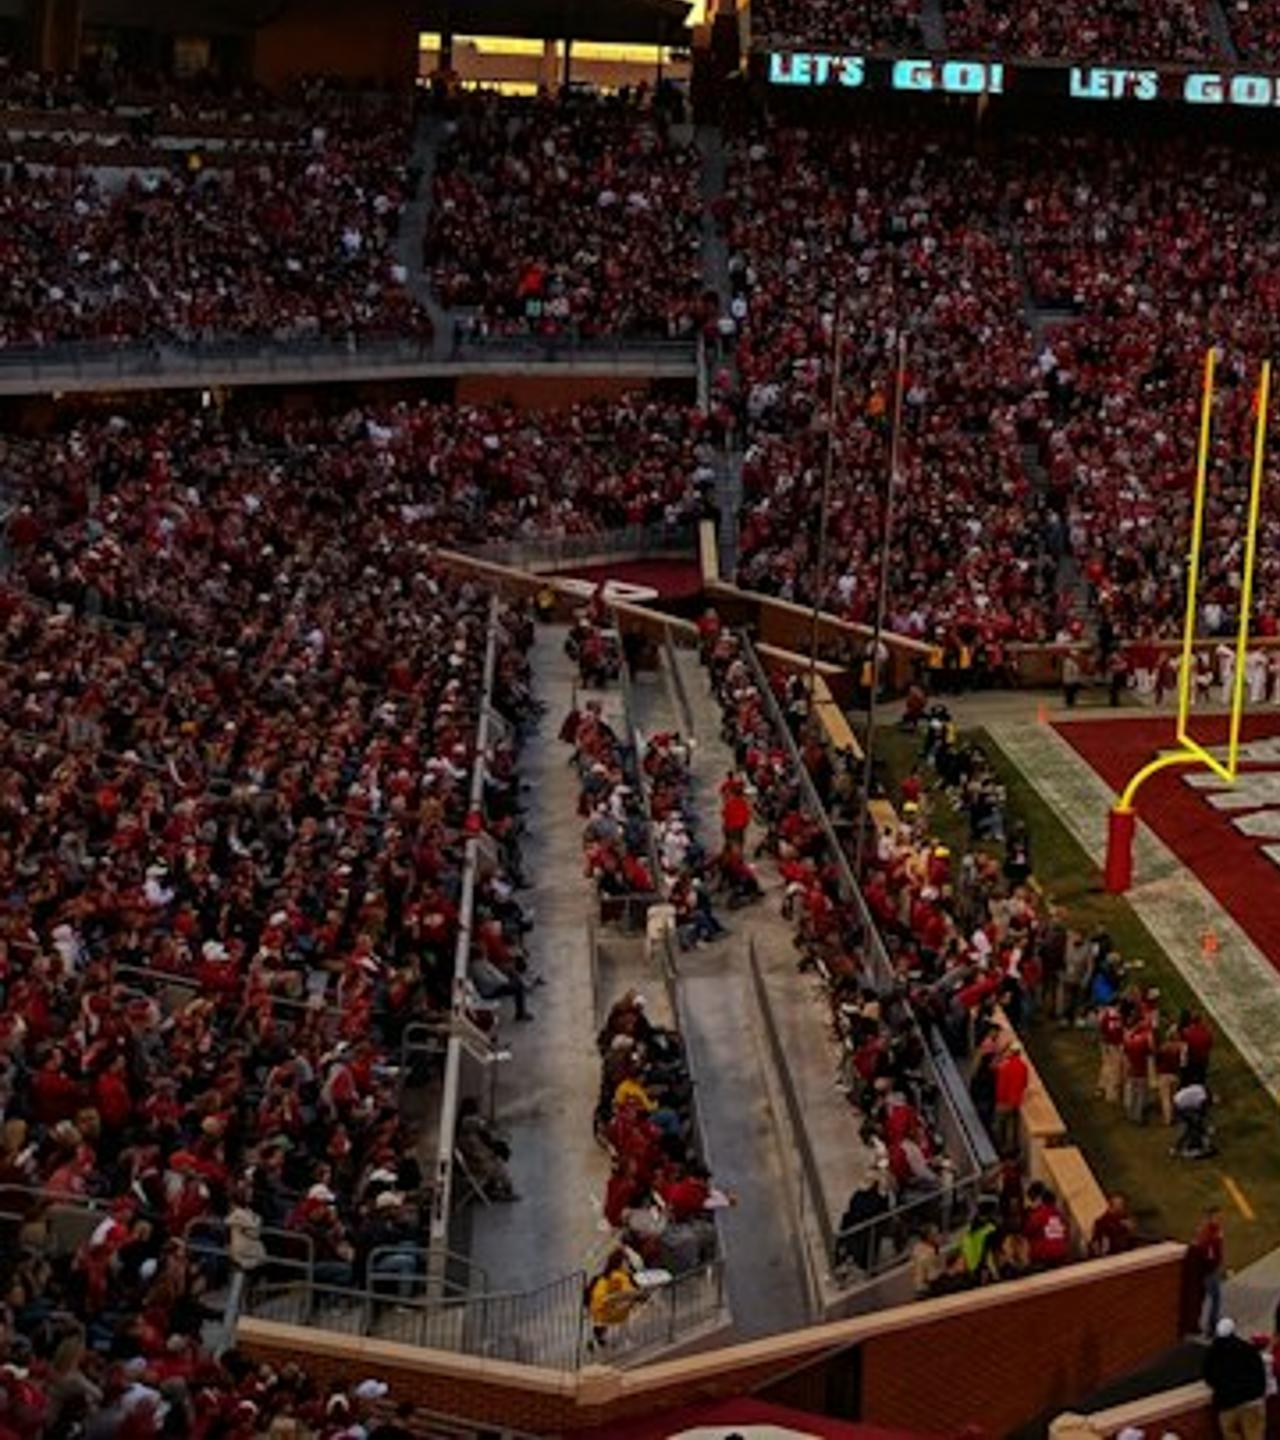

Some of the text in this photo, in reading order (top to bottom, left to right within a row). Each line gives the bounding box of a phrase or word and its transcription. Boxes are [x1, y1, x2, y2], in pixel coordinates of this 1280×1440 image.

[771, 53, 1003, 93] LET'S GO!
[1071, 67, 1158, 100] LET'S
